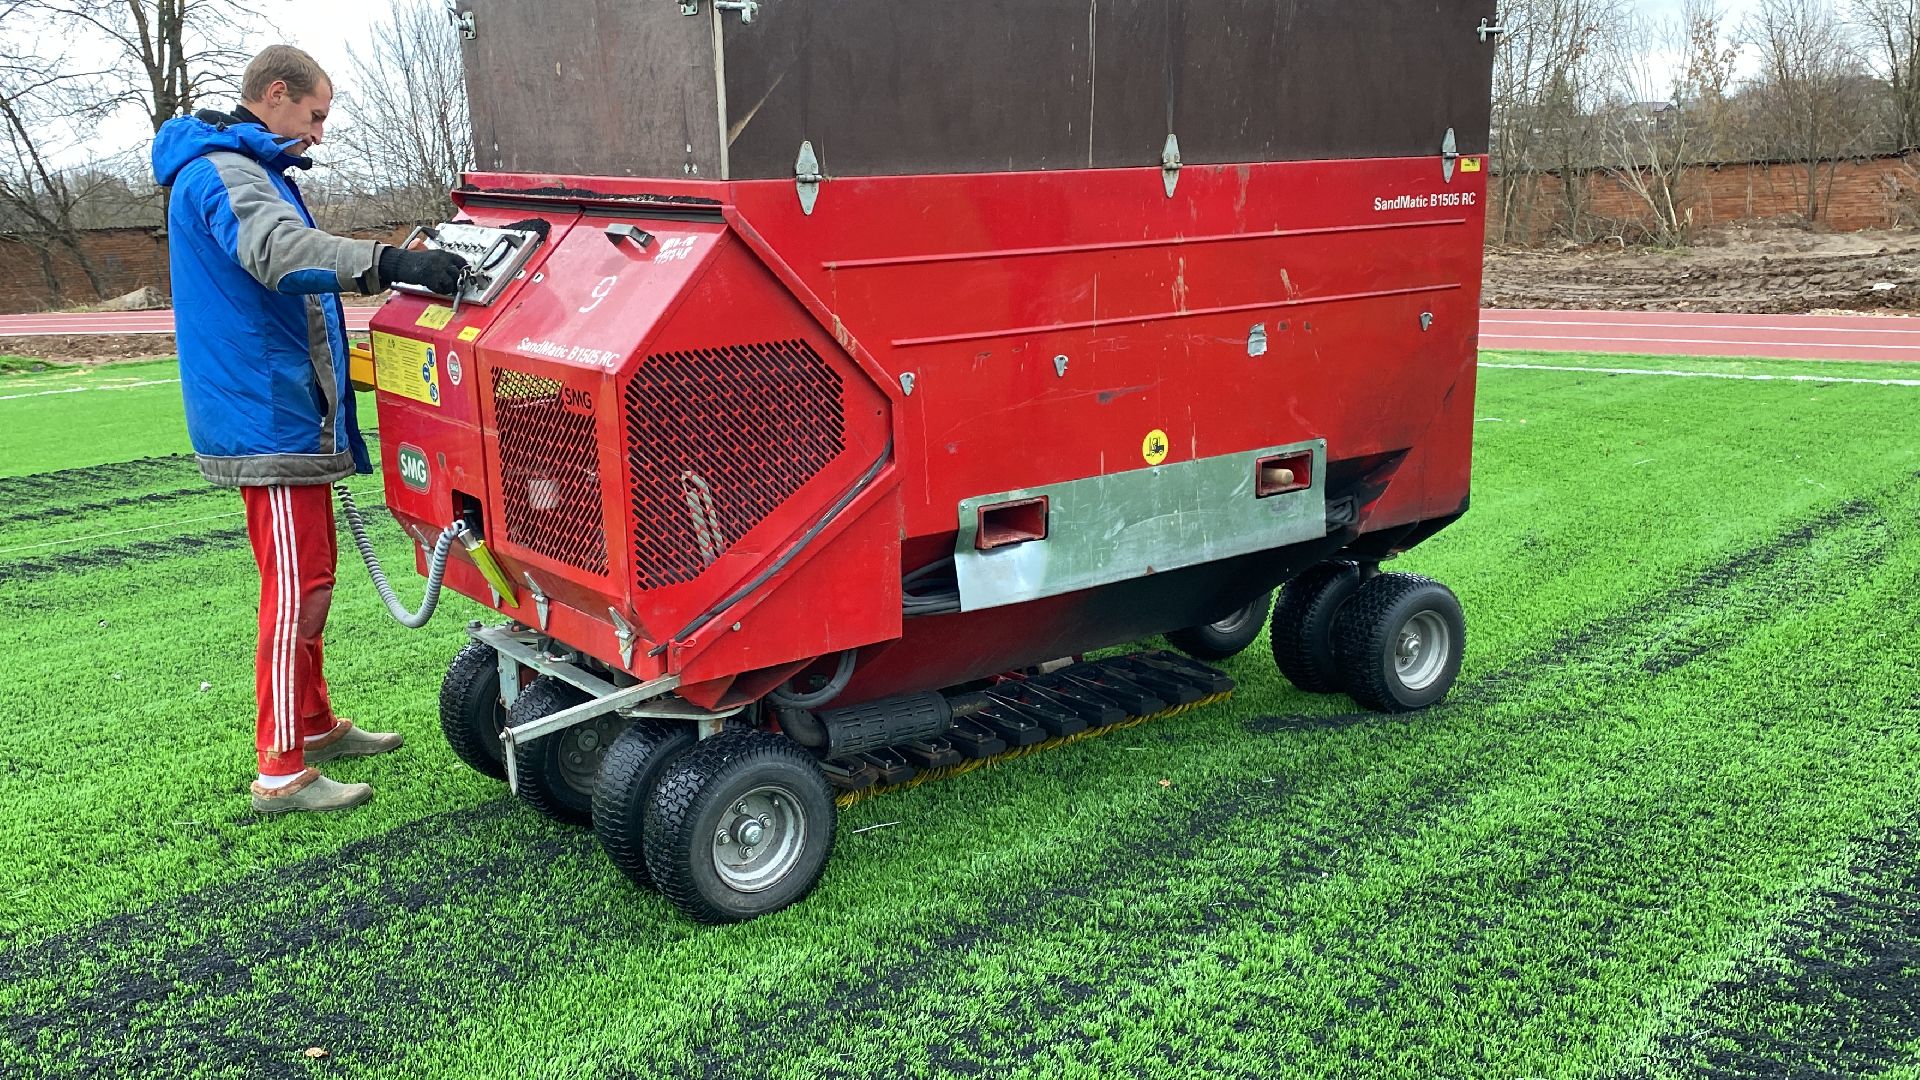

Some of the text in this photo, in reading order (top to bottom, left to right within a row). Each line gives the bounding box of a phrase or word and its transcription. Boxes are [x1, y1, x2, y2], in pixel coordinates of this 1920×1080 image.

[1374, 192, 1476, 211] SandMatic B1505 RC
[517, 337, 620, 368] SandMatic B1505 RC
[564, 387, 592, 410] SMG
[400, 453, 427, 483] SMG
